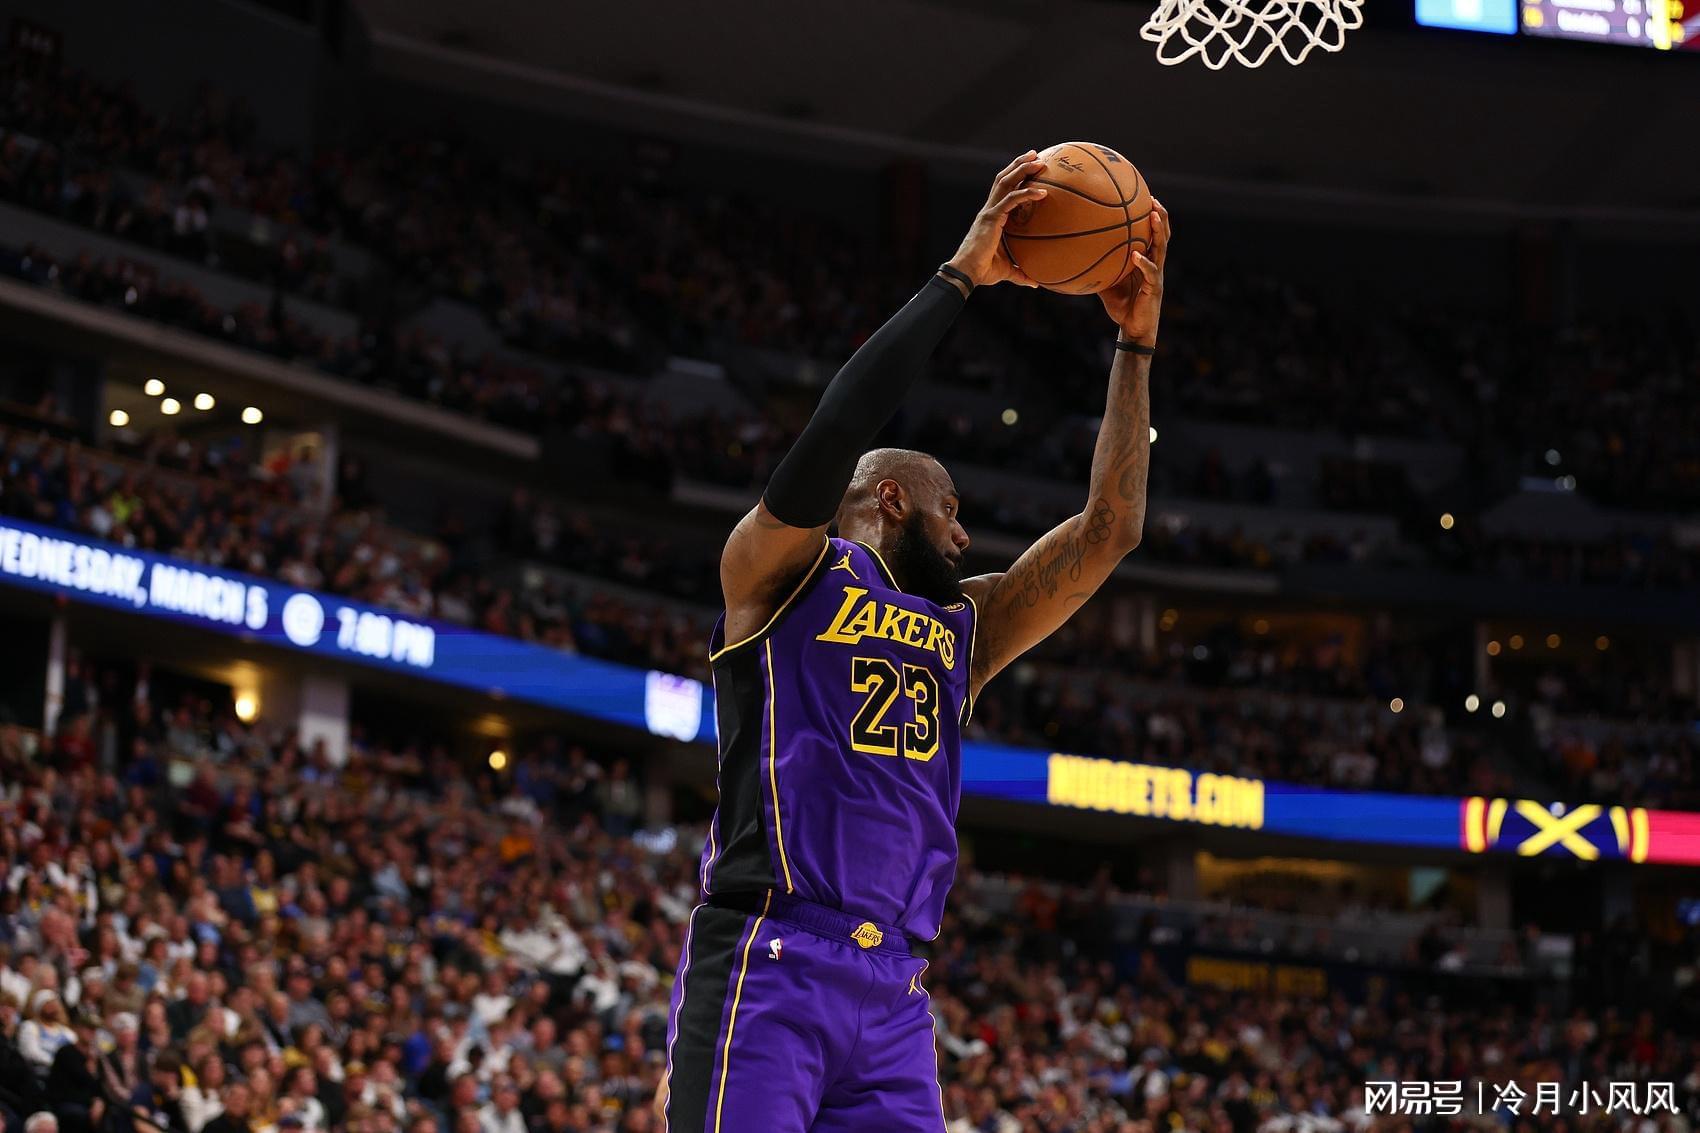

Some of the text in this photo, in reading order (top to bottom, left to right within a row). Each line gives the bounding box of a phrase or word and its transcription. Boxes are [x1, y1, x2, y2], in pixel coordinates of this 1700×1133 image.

[150, 563, 246, 625] MARCH
[247, 586, 268, 630] 5
[815, 586, 956, 670] LAKERS
[850, 656, 939, 762] 23
[1048, 753, 1264, 829] NUGGETS.COM
[854, 926, 880, 946] LAKERS
